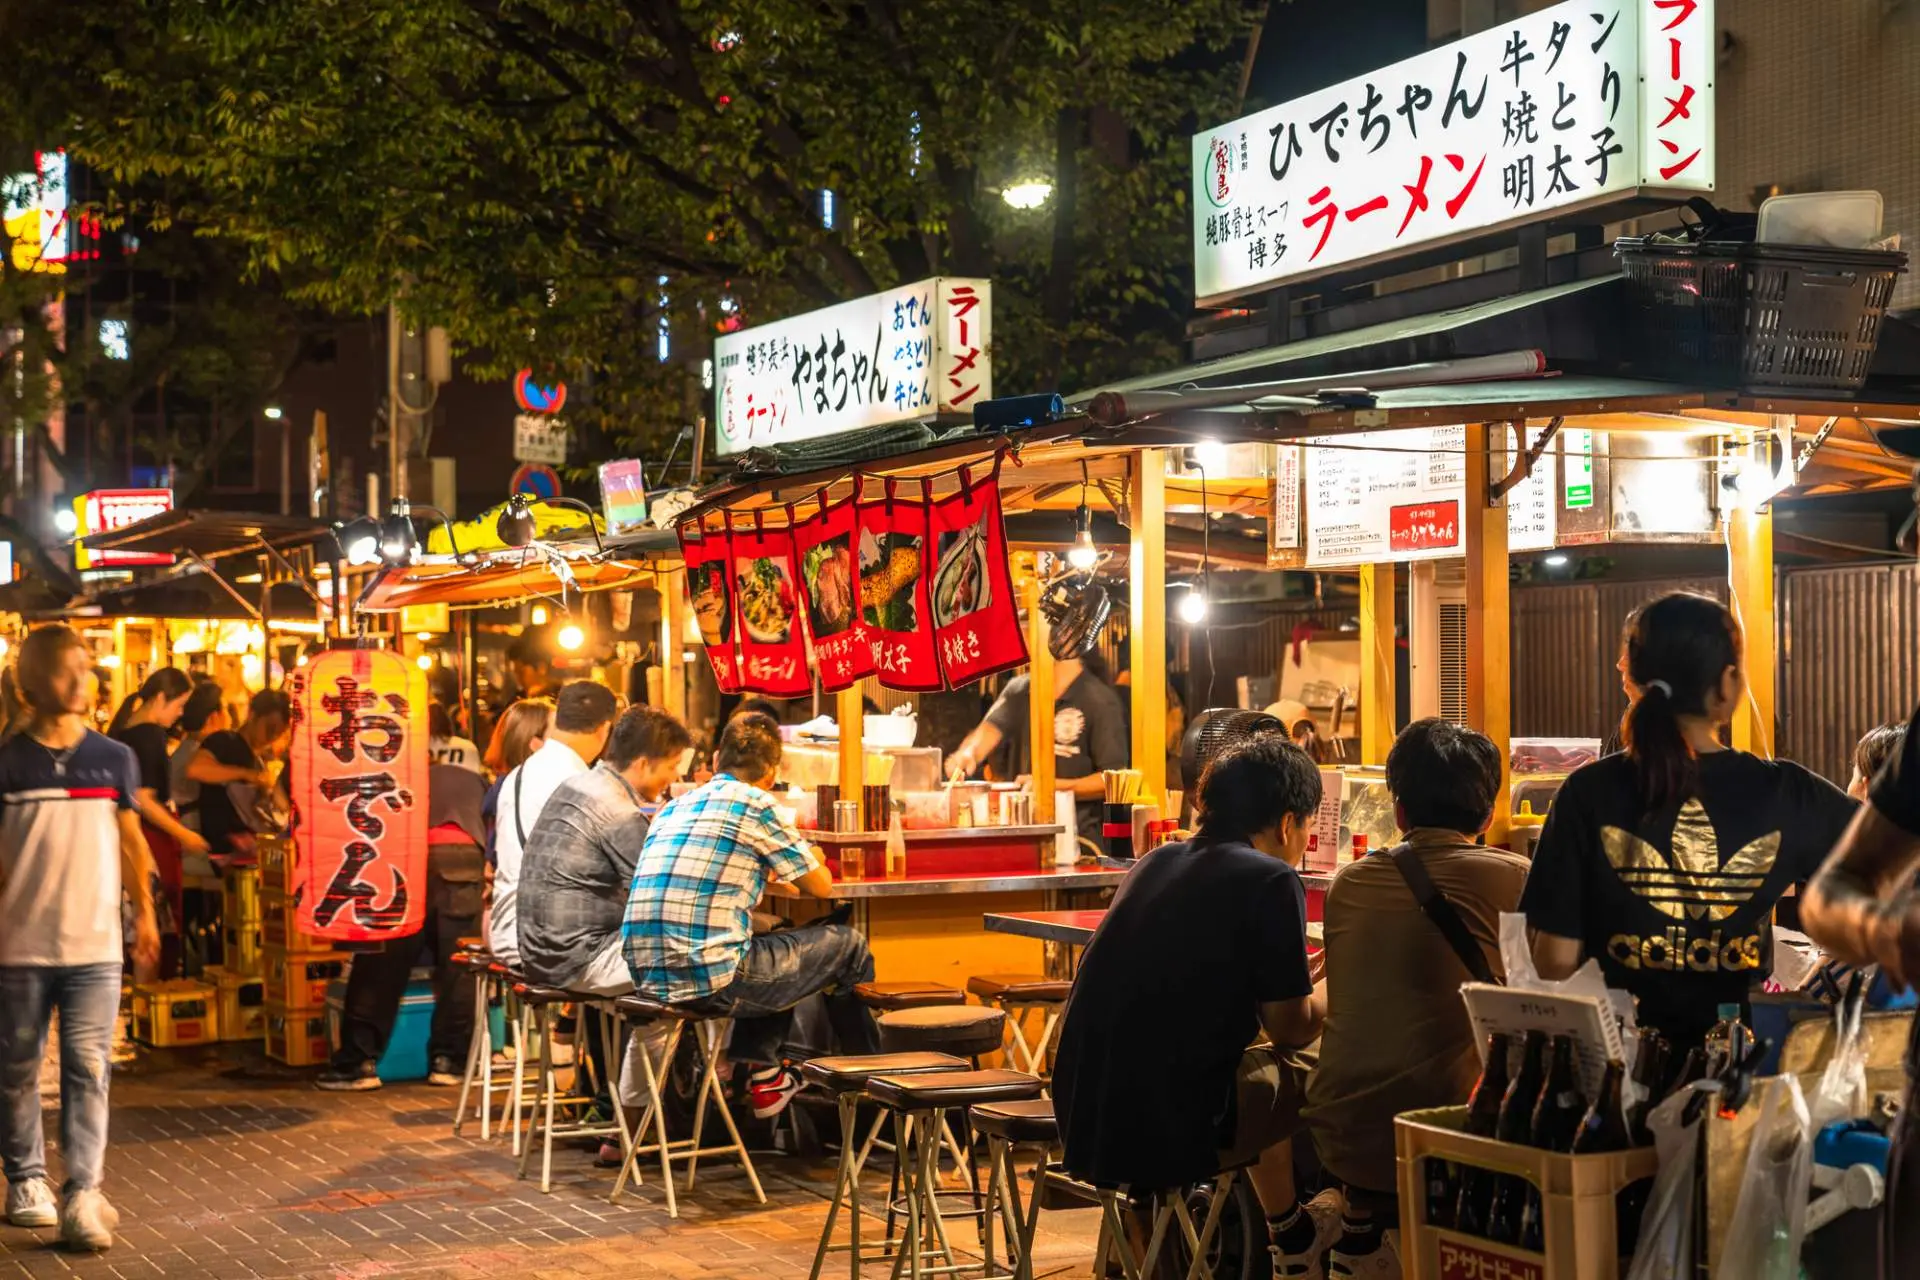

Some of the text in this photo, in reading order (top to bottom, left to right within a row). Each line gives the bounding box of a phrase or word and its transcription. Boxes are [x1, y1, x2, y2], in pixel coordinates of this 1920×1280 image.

[1500, 9, 1621, 88] 牛タン
[1653, 0, 1702, 181] ラーメン
[1268, 51, 1488, 181] ひでちゃん
[1501, 62, 1621, 148] 焼とり
[1302, 151, 1488, 263] ラーメン
[1502, 126, 1624, 210] 明太子
[1247, 232, 1288, 270] 博多
[791, 321, 888, 415] やまちゃん
[948, 286, 980, 406] ラーメン
[893, 376, 932, 412] 牛たん
[312, 675, 414, 930] おでん
[1607, 926, 1761, 971] adidas
